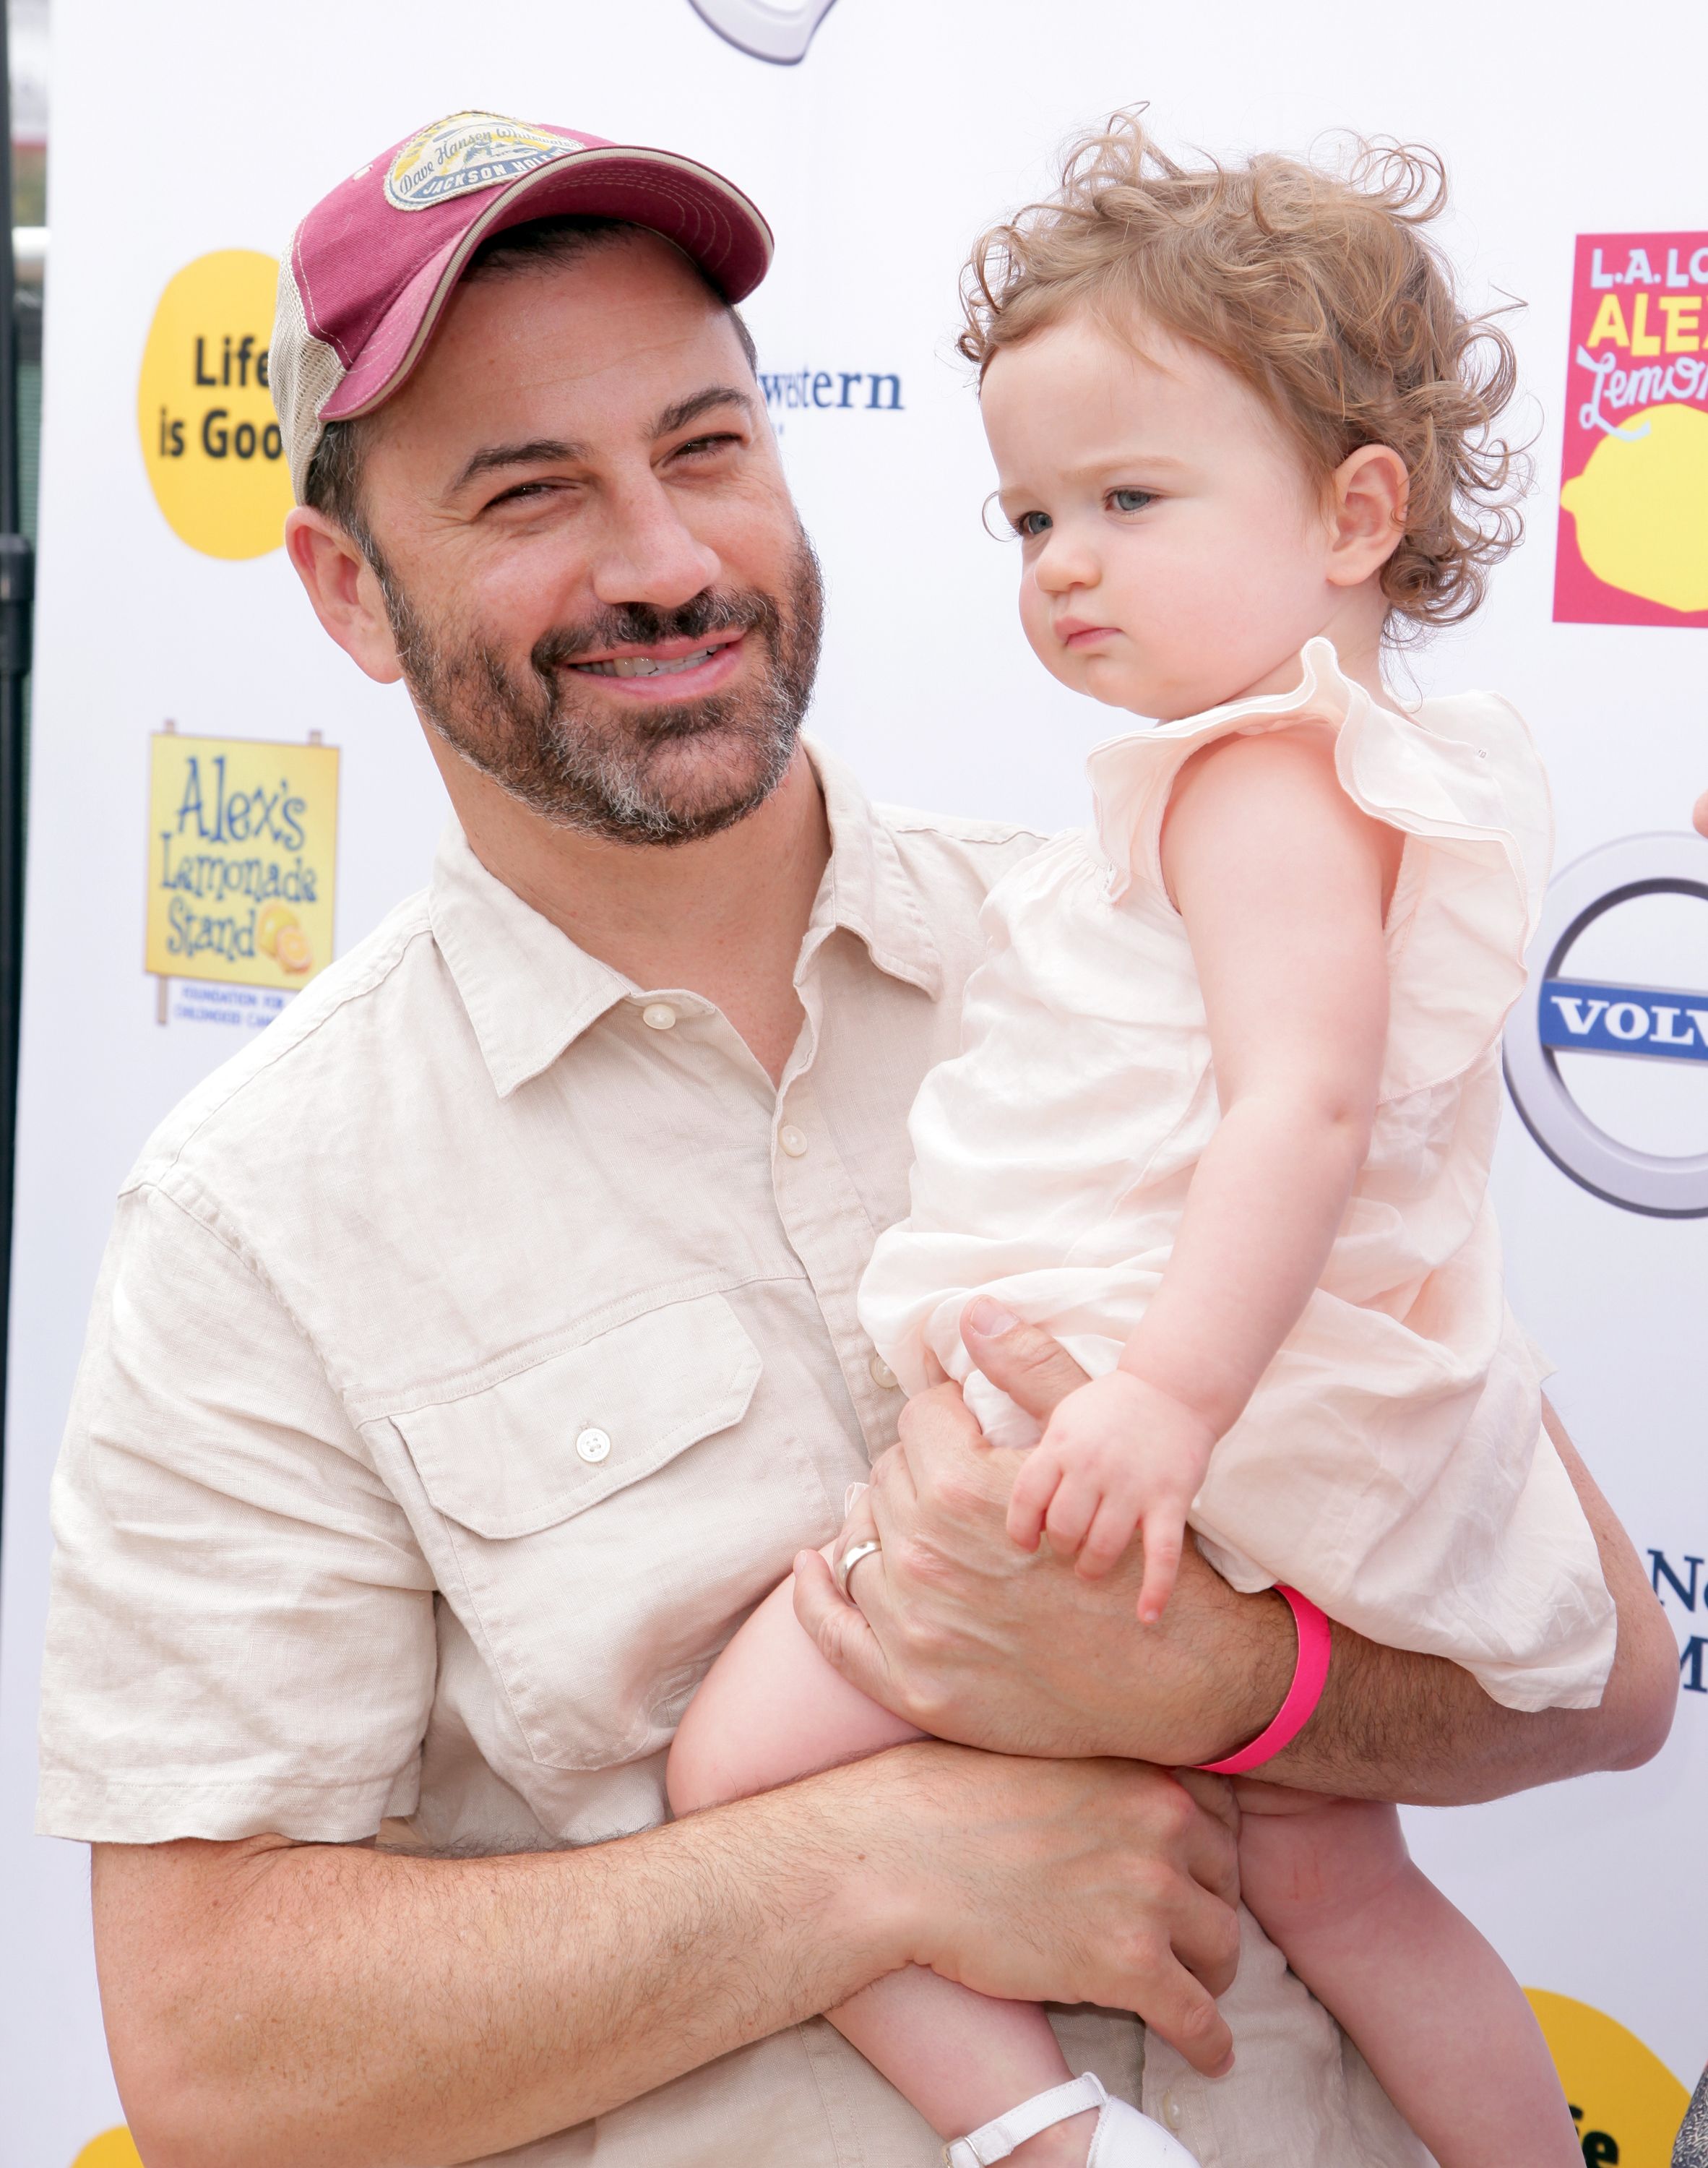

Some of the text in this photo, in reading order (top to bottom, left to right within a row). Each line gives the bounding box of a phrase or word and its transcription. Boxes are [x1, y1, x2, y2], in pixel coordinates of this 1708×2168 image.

[400, 162, 435, 195] Dave
[435, 132, 492, 165] Hansen
[423, 164, 507, 194] JACKSON
[1591, 248, 1661, 288] L.A.
[1587, 293, 1708, 356] ALE
[194, 335, 270, 388] Life
[159, 406, 185, 458] is
[178, 756, 306, 851] Alex's
[160, 833, 317, 903] Lemonade
[167, 896, 256, 963] Stand
